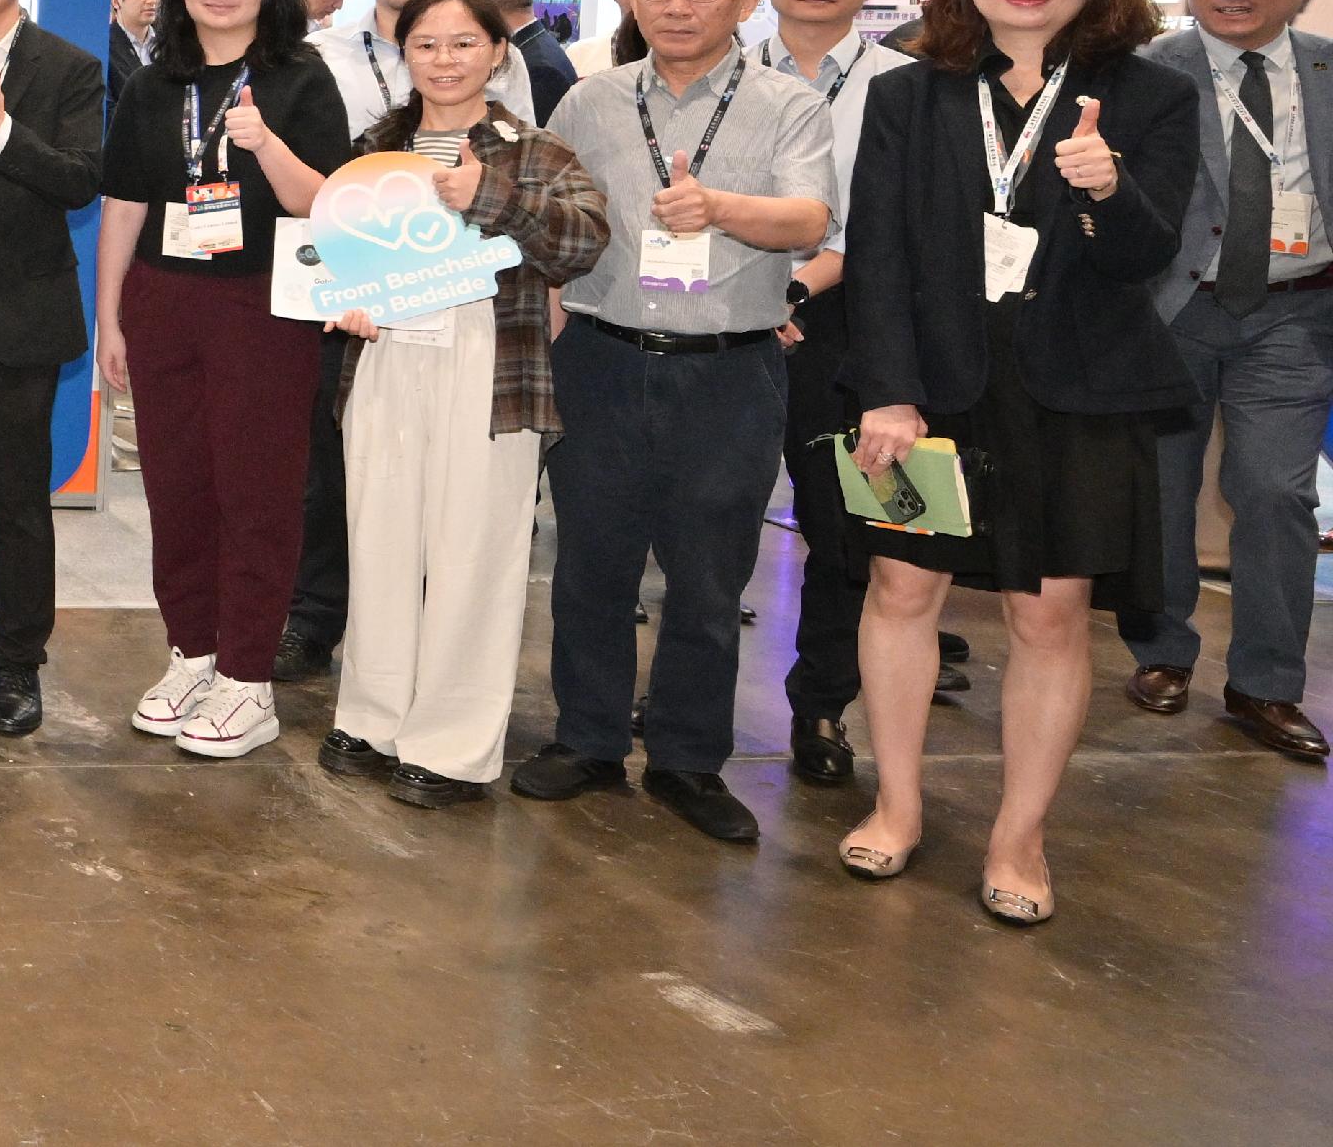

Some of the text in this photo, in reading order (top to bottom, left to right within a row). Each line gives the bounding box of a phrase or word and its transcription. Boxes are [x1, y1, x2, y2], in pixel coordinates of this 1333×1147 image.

[319, 244, 513, 308] From Benchside
[389, 276, 487, 313] Bedside
